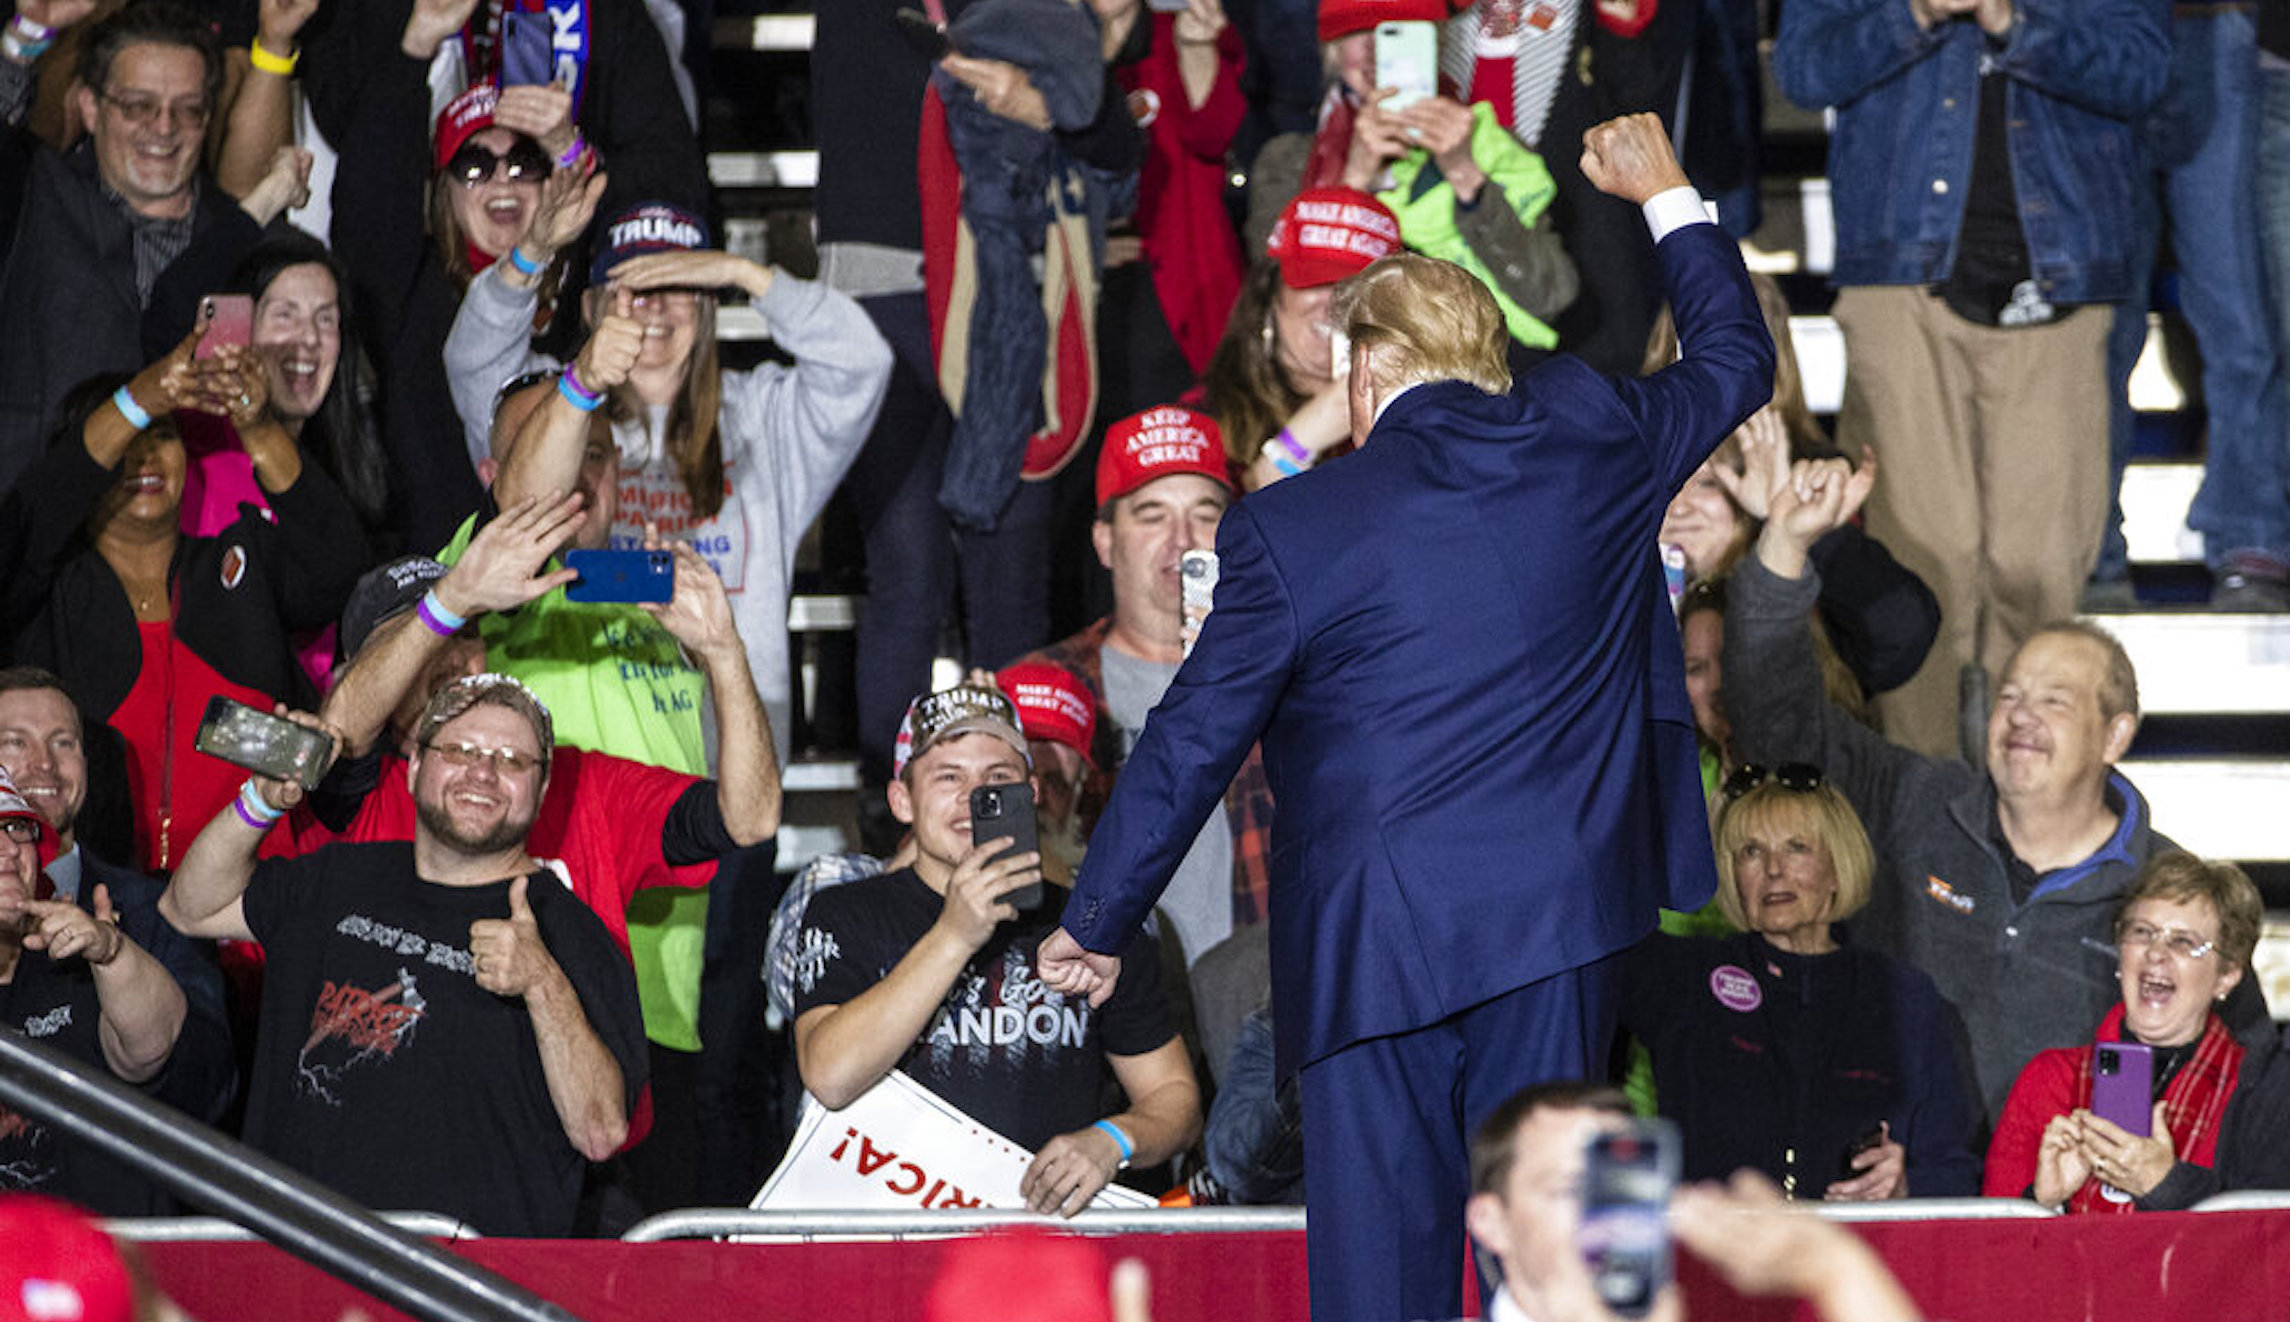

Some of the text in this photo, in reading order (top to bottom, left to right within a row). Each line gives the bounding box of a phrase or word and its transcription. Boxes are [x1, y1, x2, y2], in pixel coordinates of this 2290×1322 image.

[608, 217, 702, 249] TRUMP
[1141, 409, 1190, 429] KEEP
[1126, 427, 1209, 455] AMERICA
[1138, 445, 1199, 467] GREAT
[921, 689, 1004, 715] TRUMP
[927, 1004, 1090, 1048] ANDON
[830, 1126, 984, 1209] RICA!
